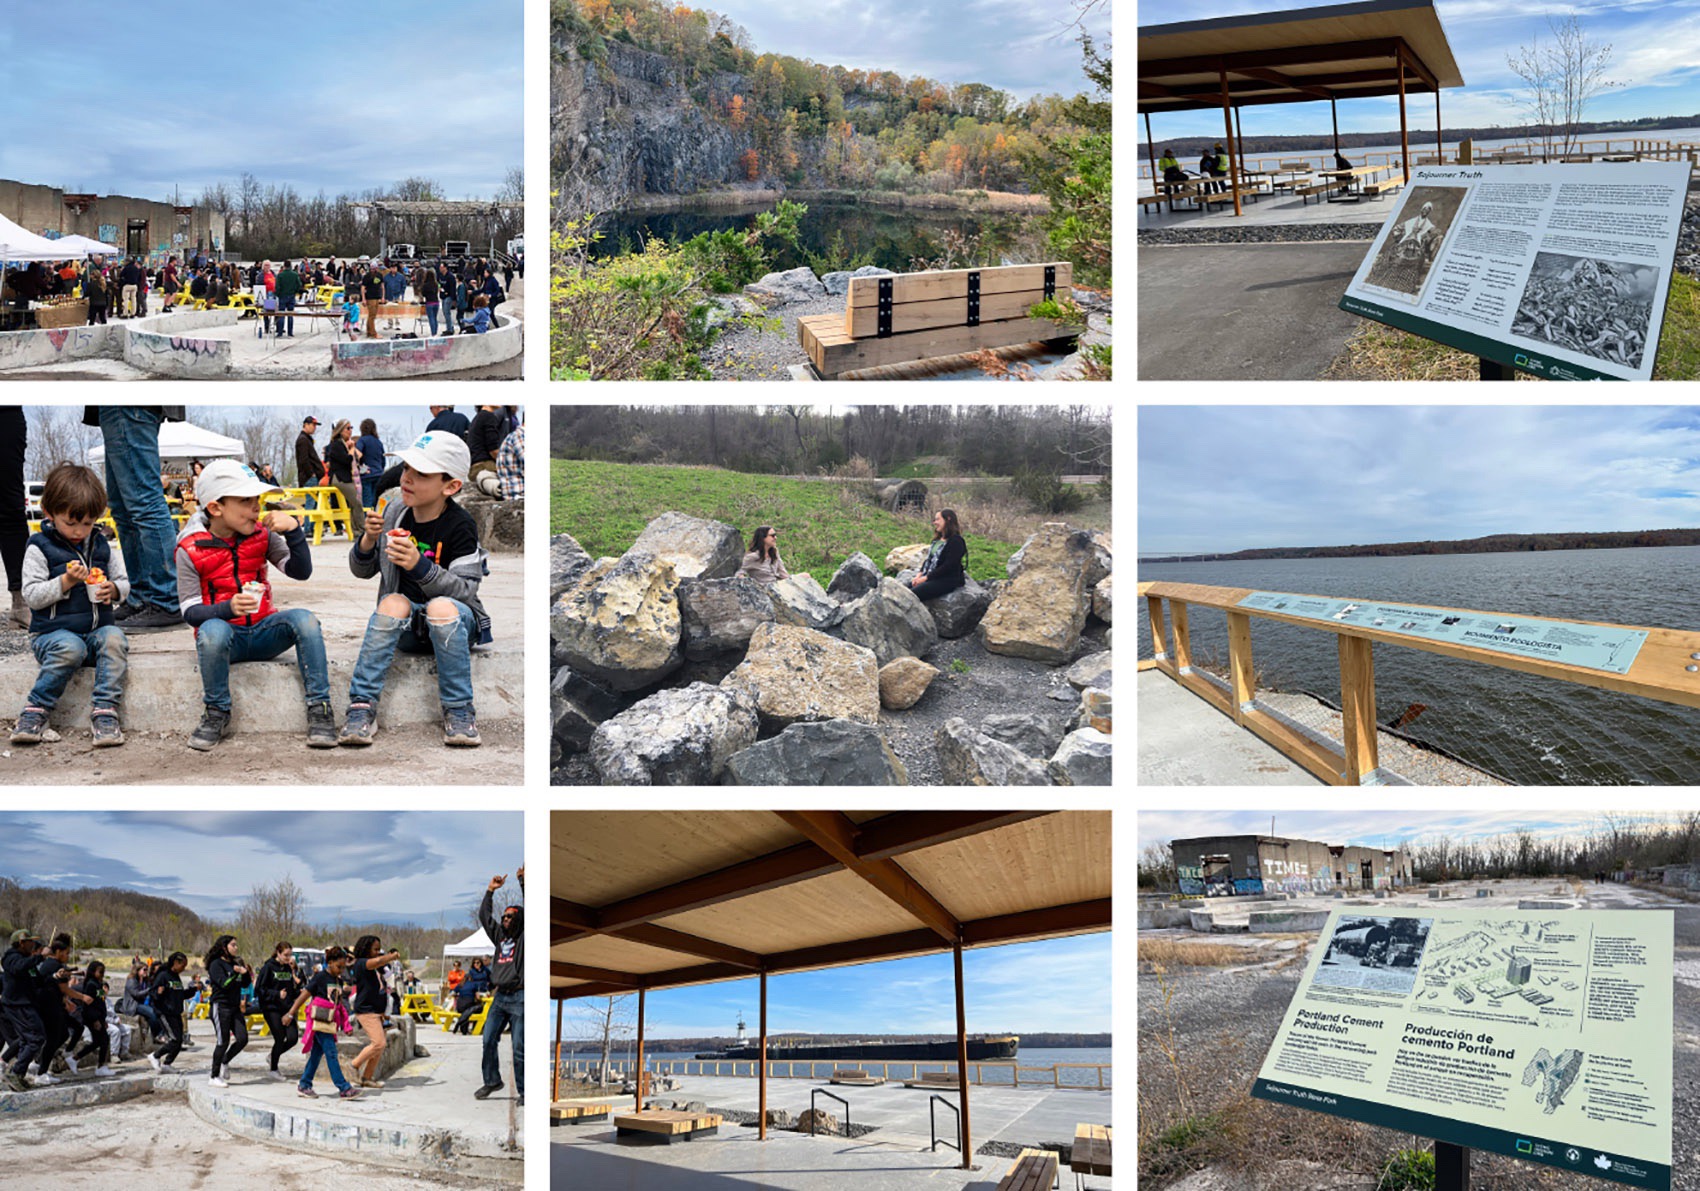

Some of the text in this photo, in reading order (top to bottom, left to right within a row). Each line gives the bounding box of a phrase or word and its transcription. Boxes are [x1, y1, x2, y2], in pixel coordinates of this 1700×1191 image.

[1417, 171, 1483, 180] Sojourner Truth
[1464, 630, 1510, 642] MOVIMIENTO
[1510, 637, 1562, 651] ECOLOGISTA
[1293, 1018, 1349, 1034] Production
[1298, 1009, 1384, 1029] Portland Cement
[1405, 1023, 1494, 1044] Producción de
[1402, 1035, 1515, 1059] cemento Portland
